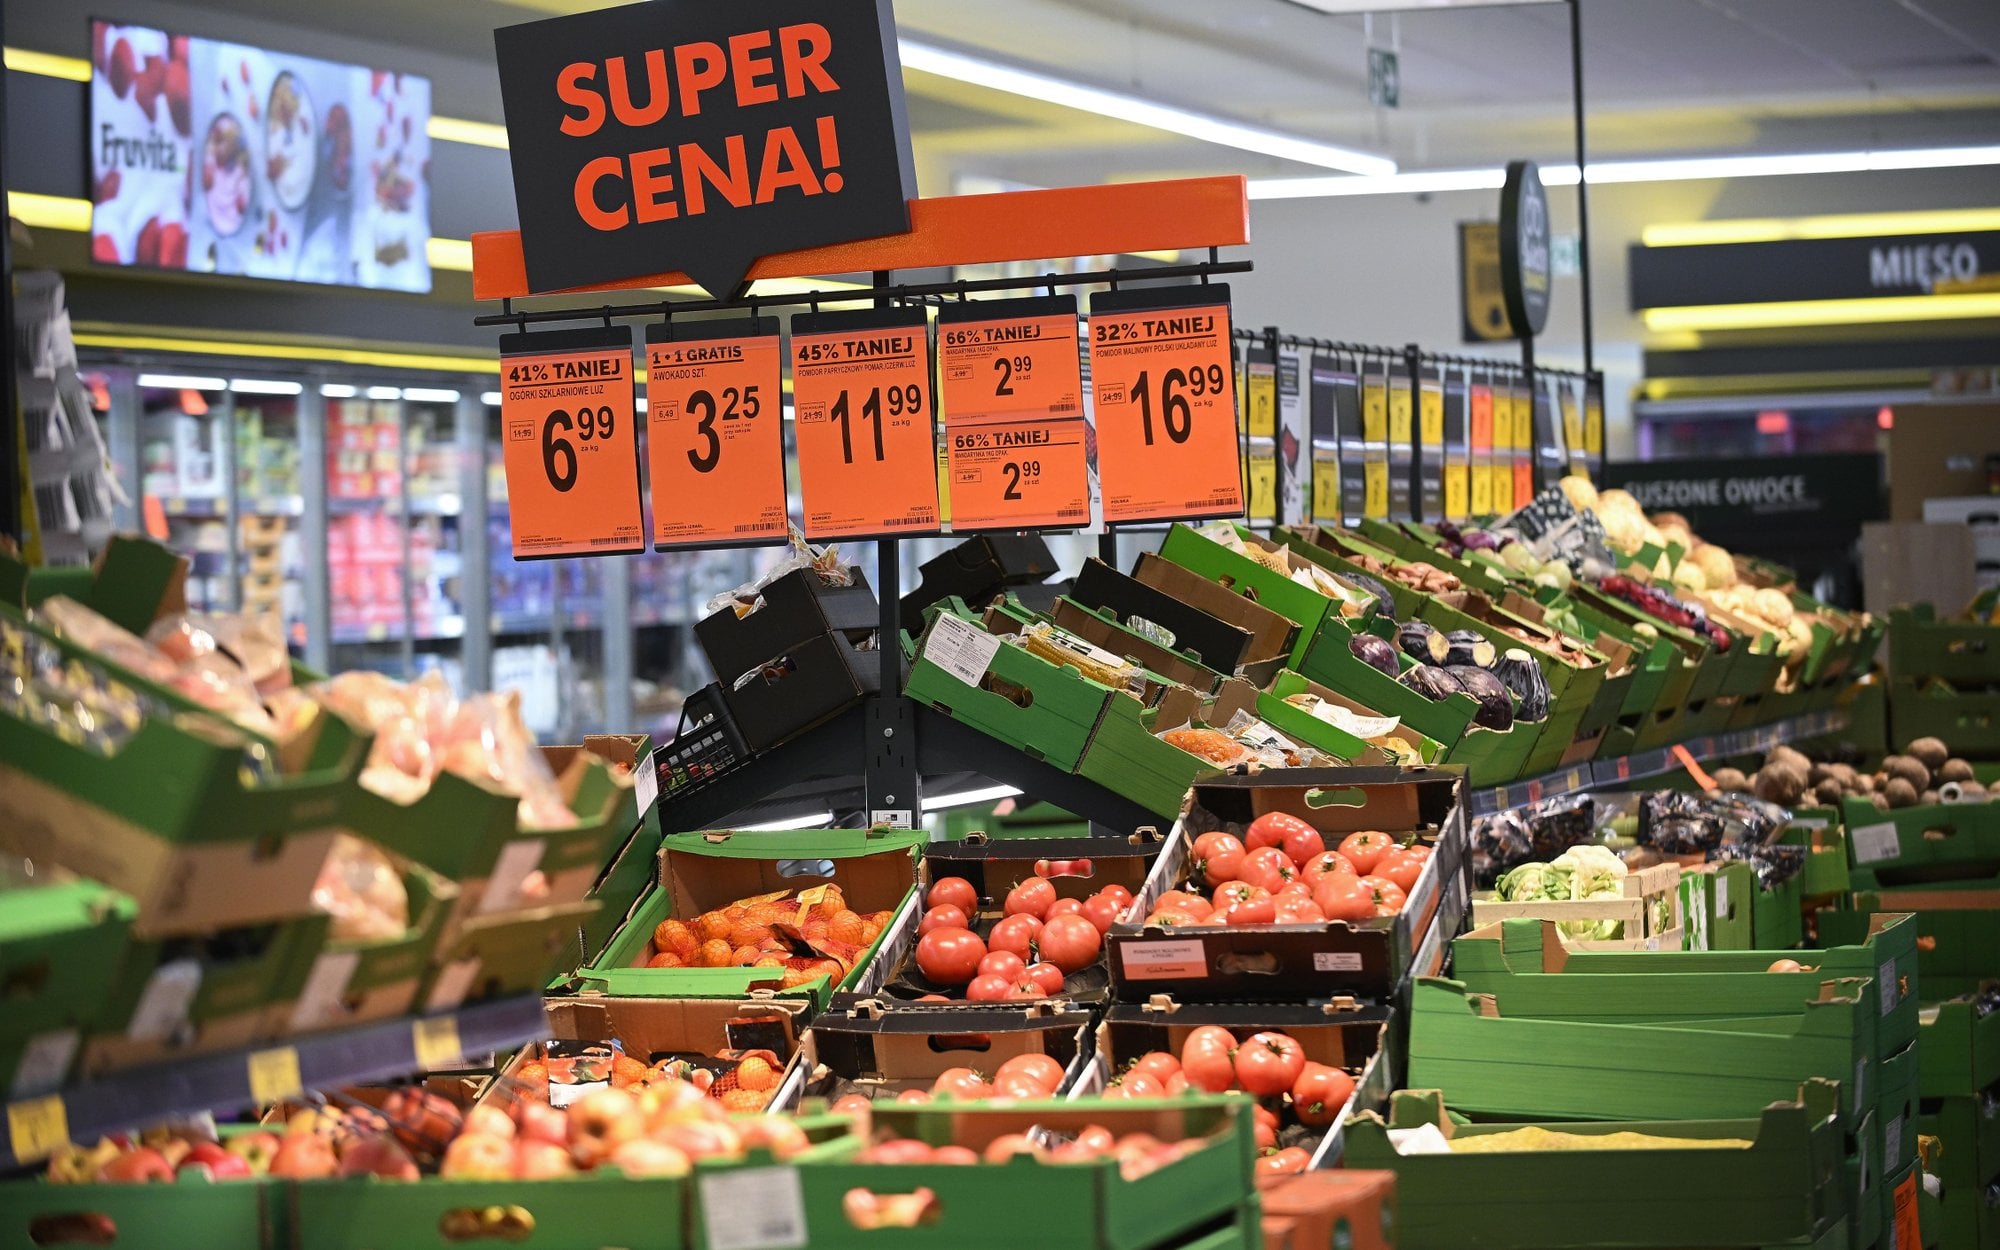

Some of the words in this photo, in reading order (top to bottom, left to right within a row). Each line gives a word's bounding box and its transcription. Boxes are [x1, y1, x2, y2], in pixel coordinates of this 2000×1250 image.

[556, 22, 840, 137] SUPER
[574, 115, 843, 231] CENA!
[1869, 242, 1979, 294] MIĘSO
[946, 330, 980, 344] 66%
[984, 325, 1040, 342] TANIEJ
[1096, 323, 1138, 342] 32%
[1143, 316, 1214, 337] TANIEJ
[652, 352, 660, 364] 1
[674, 350, 682, 362] 1
[686, 346, 742, 361] GRATIS
[798, 344, 838, 361] 45%
[843, 337, 912, 357] TANIEJ
[1096, 348, 1122, 358] POMIDOR
[1123, 346, 1153, 356] MALINOWY
[1154, 344, 1174, 352] POLSKI
[510, 364, 548, 382] 41%
[552, 358, 620, 378] TANIEJ
[654, 370, 690, 381] AWOKADO
[798, 368, 823, 376] POMIDOR
[824, 365, 864, 376] PAPRYCZKOWY
[994, 358, 1014, 396] 2
[1014, 356, 1032, 372] 99
[510, 388, 537, 400] OGÓRKI
[538, 386, 588, 398] SZKLARNIOWE
[591, 385, 604, 394] LUZ
[1130, 367, 1191, 446] 16
[1188, 364, 1224, 396] 99
[1203, 400, 1213, 408] kg
[685, 390, 720, 474] 3
[722, 386, 760, 421] 25
[830, 387, 885, 464] 11
[887, 384, 922, 416] 99
[901, 418, 910, 426] kg
[541, 409, 578, 493] 6
[577, 406, 614, 441] 99
[956, 434, 989, 448] 66%
[993, 430, 1050, 446] TANIEJ
[1002, 462, 1022, 500] 2
[1022, 460, 1040, 477] 99
[1724, 474, 1806, 506] OWOCE
